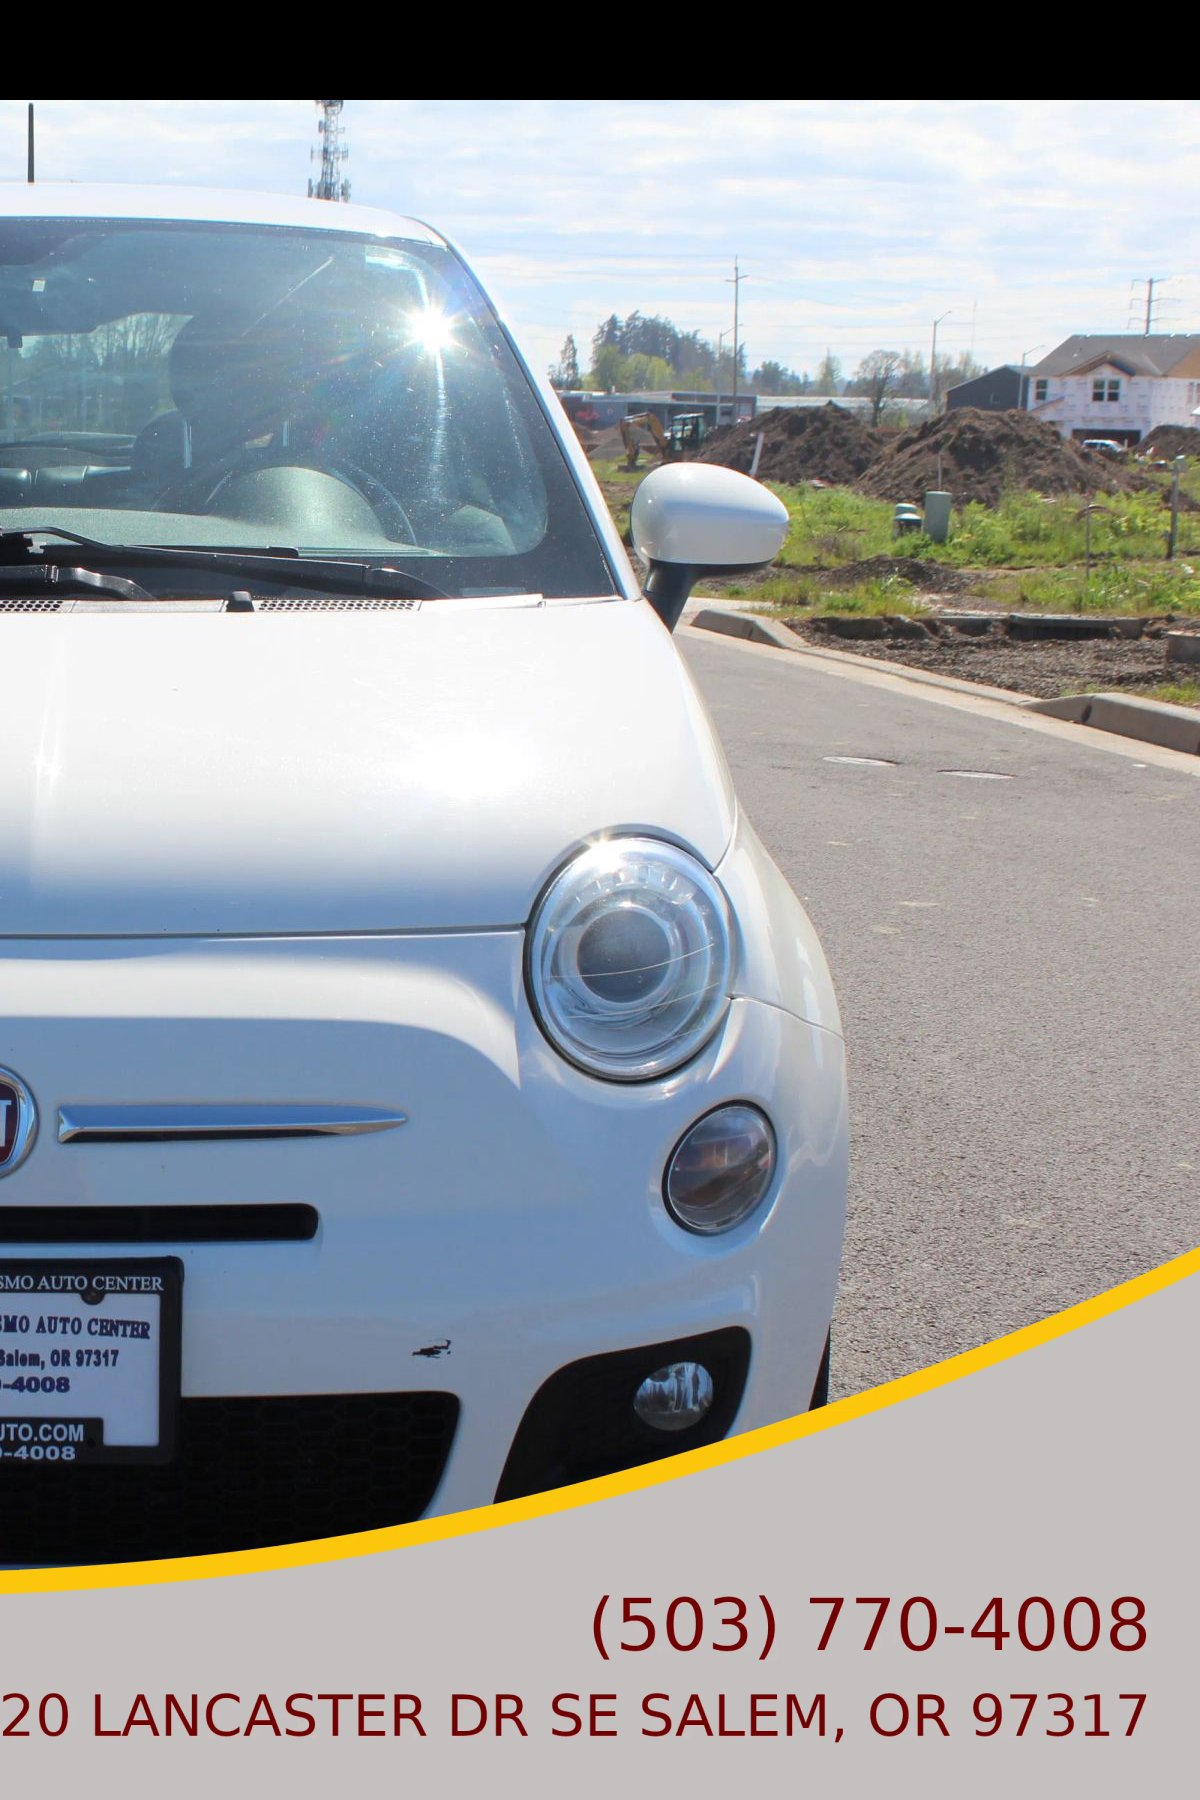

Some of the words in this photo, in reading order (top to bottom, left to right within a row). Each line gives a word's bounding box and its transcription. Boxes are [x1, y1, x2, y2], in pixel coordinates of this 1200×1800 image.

[37, 1276, 88, 1291] AUTO
[93, 1276, 164, 1292] CENTER
[35, 1315, 83, 1336] AUTO
[86, 1317, 151, 1340] CENTER
[50, 1348, 71, 1367] OR
[75, 1348, 120, 1368] 97317
